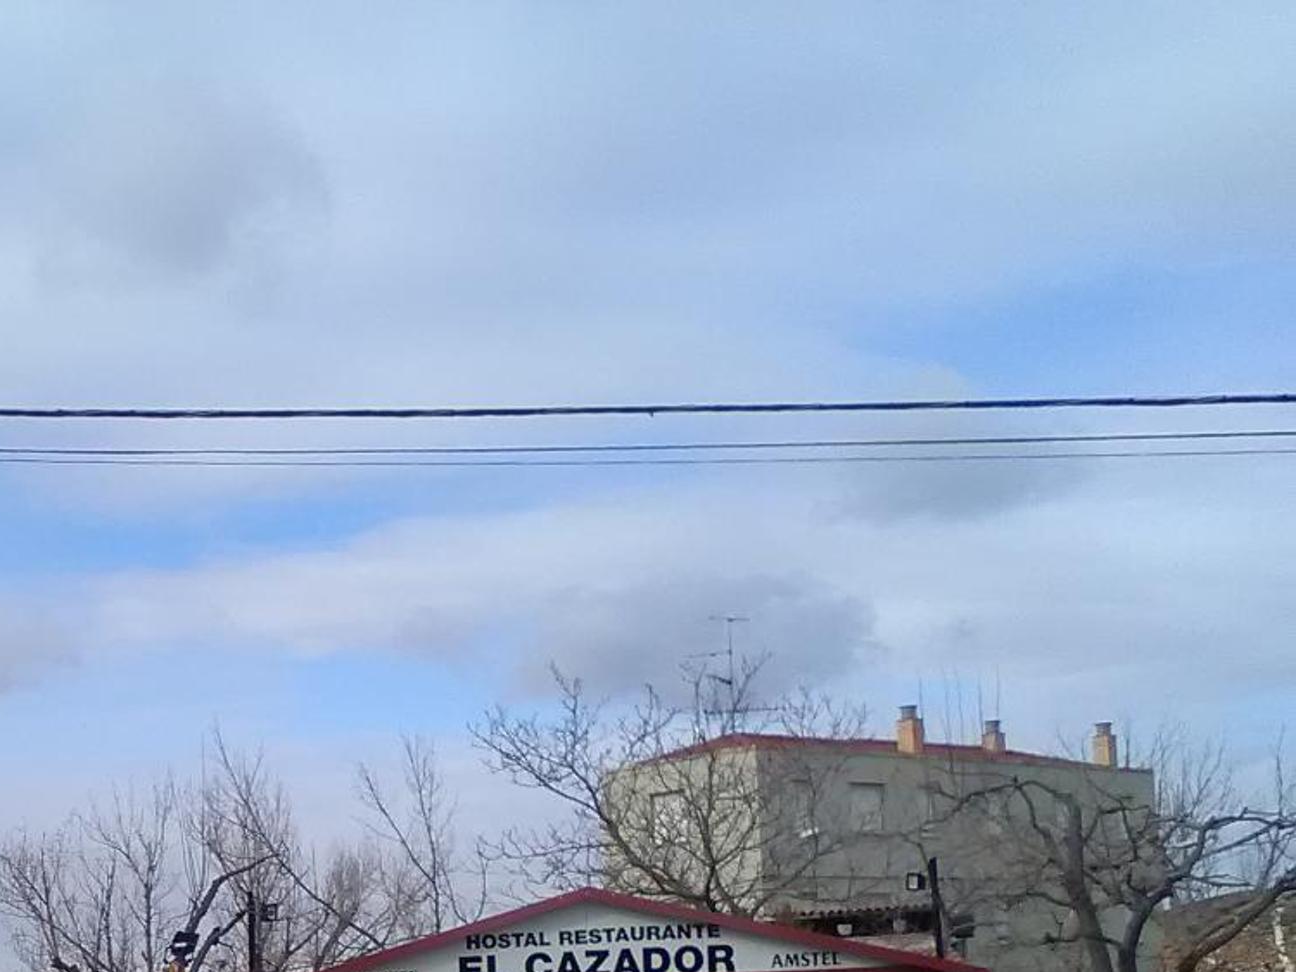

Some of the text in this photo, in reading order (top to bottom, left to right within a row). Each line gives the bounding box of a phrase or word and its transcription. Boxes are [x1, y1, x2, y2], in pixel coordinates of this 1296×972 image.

[466, 923, 722, 950] HOSTAL RESTAURANTE
[771, 951, 842, 969] AMSTEL
